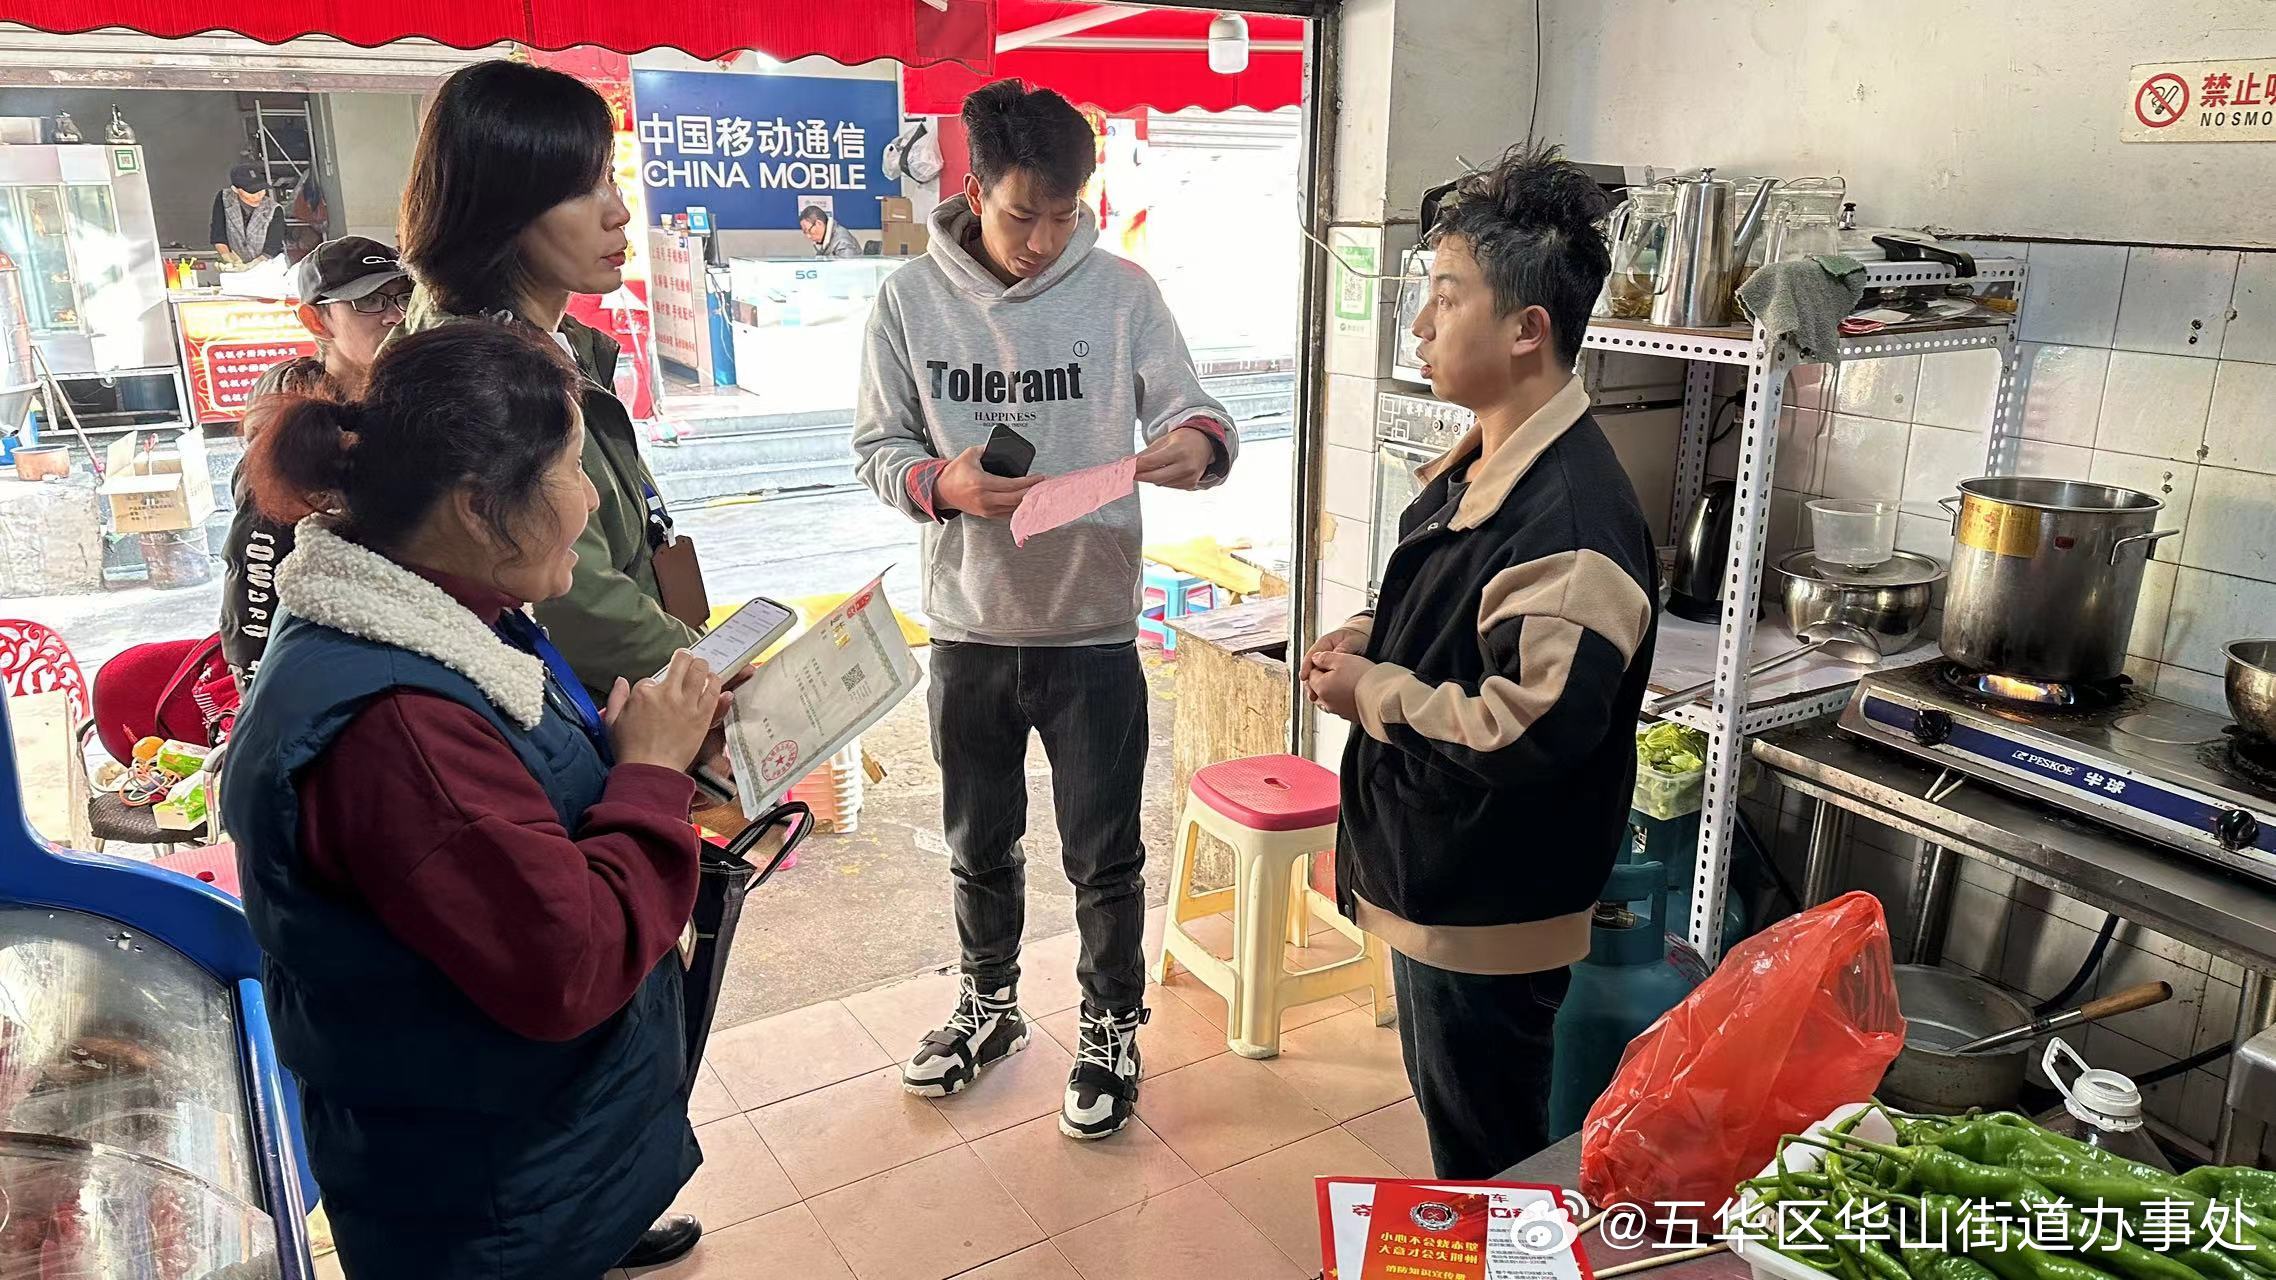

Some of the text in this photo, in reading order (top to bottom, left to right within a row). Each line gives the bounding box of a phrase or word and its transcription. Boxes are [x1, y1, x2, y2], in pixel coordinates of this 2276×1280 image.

[2200, 112, 2225, 126] NO
[639, 112, 866, 160] 中国移动通信
[643, 159, 867, 190] CHINA MOBILE
[795, 269, 817, 280] 5G
[927, 360, 1083, 404] Tolerant
[975, 411, 1037, 421] HAPPINESS
[2027, 754, 2075, 776] PESKOE
[2083, 771, 2126, 794] 半球
